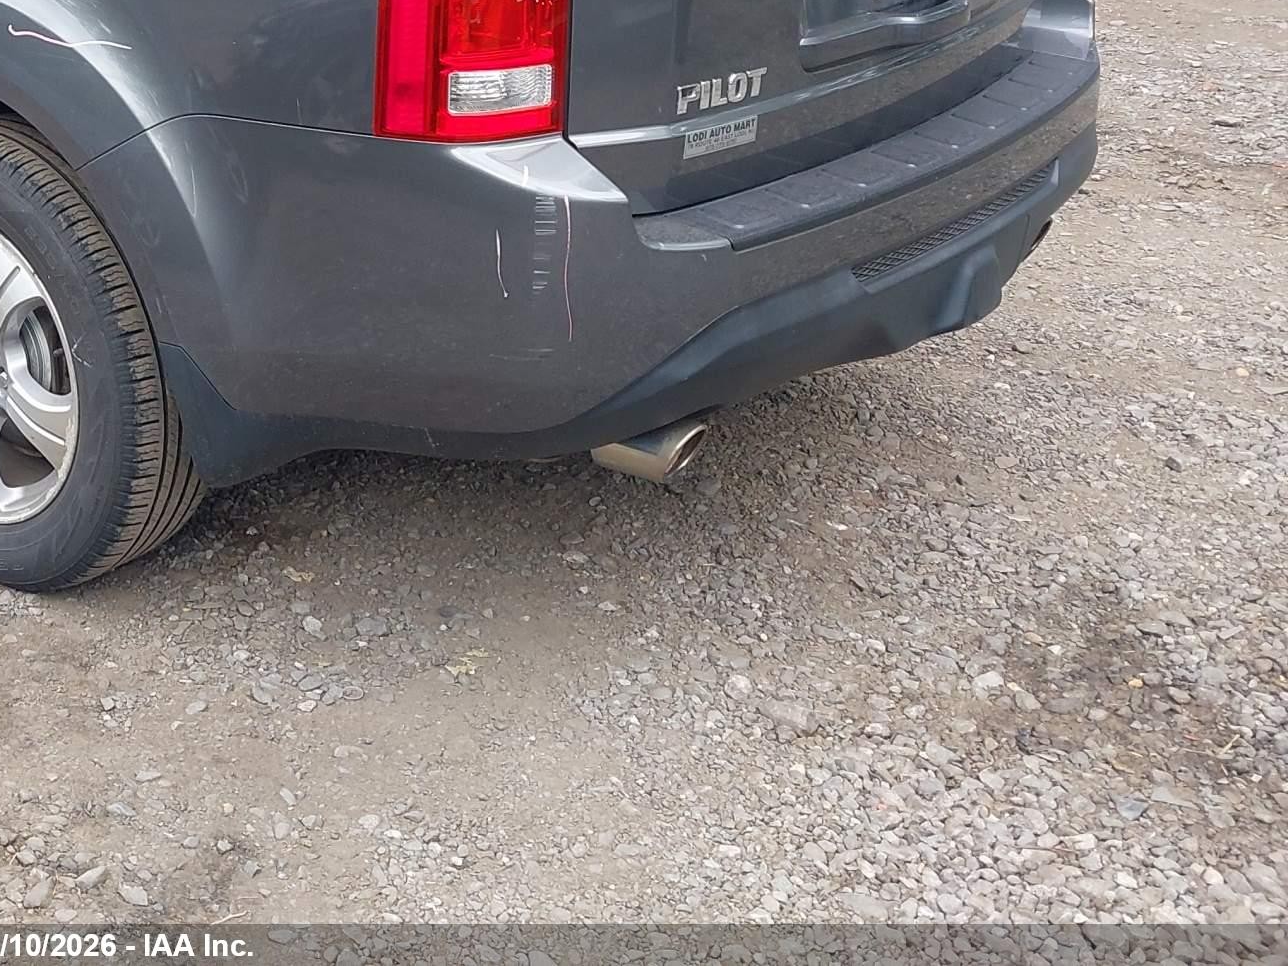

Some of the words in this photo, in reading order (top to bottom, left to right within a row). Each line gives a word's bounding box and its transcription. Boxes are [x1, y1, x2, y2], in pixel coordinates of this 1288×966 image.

[676, 66, 768, 115] PILOT
[687, 131, 707, 143] LODI
[710, 125, 732, 138] AUTO
[734, 118, 756, 131] MART
